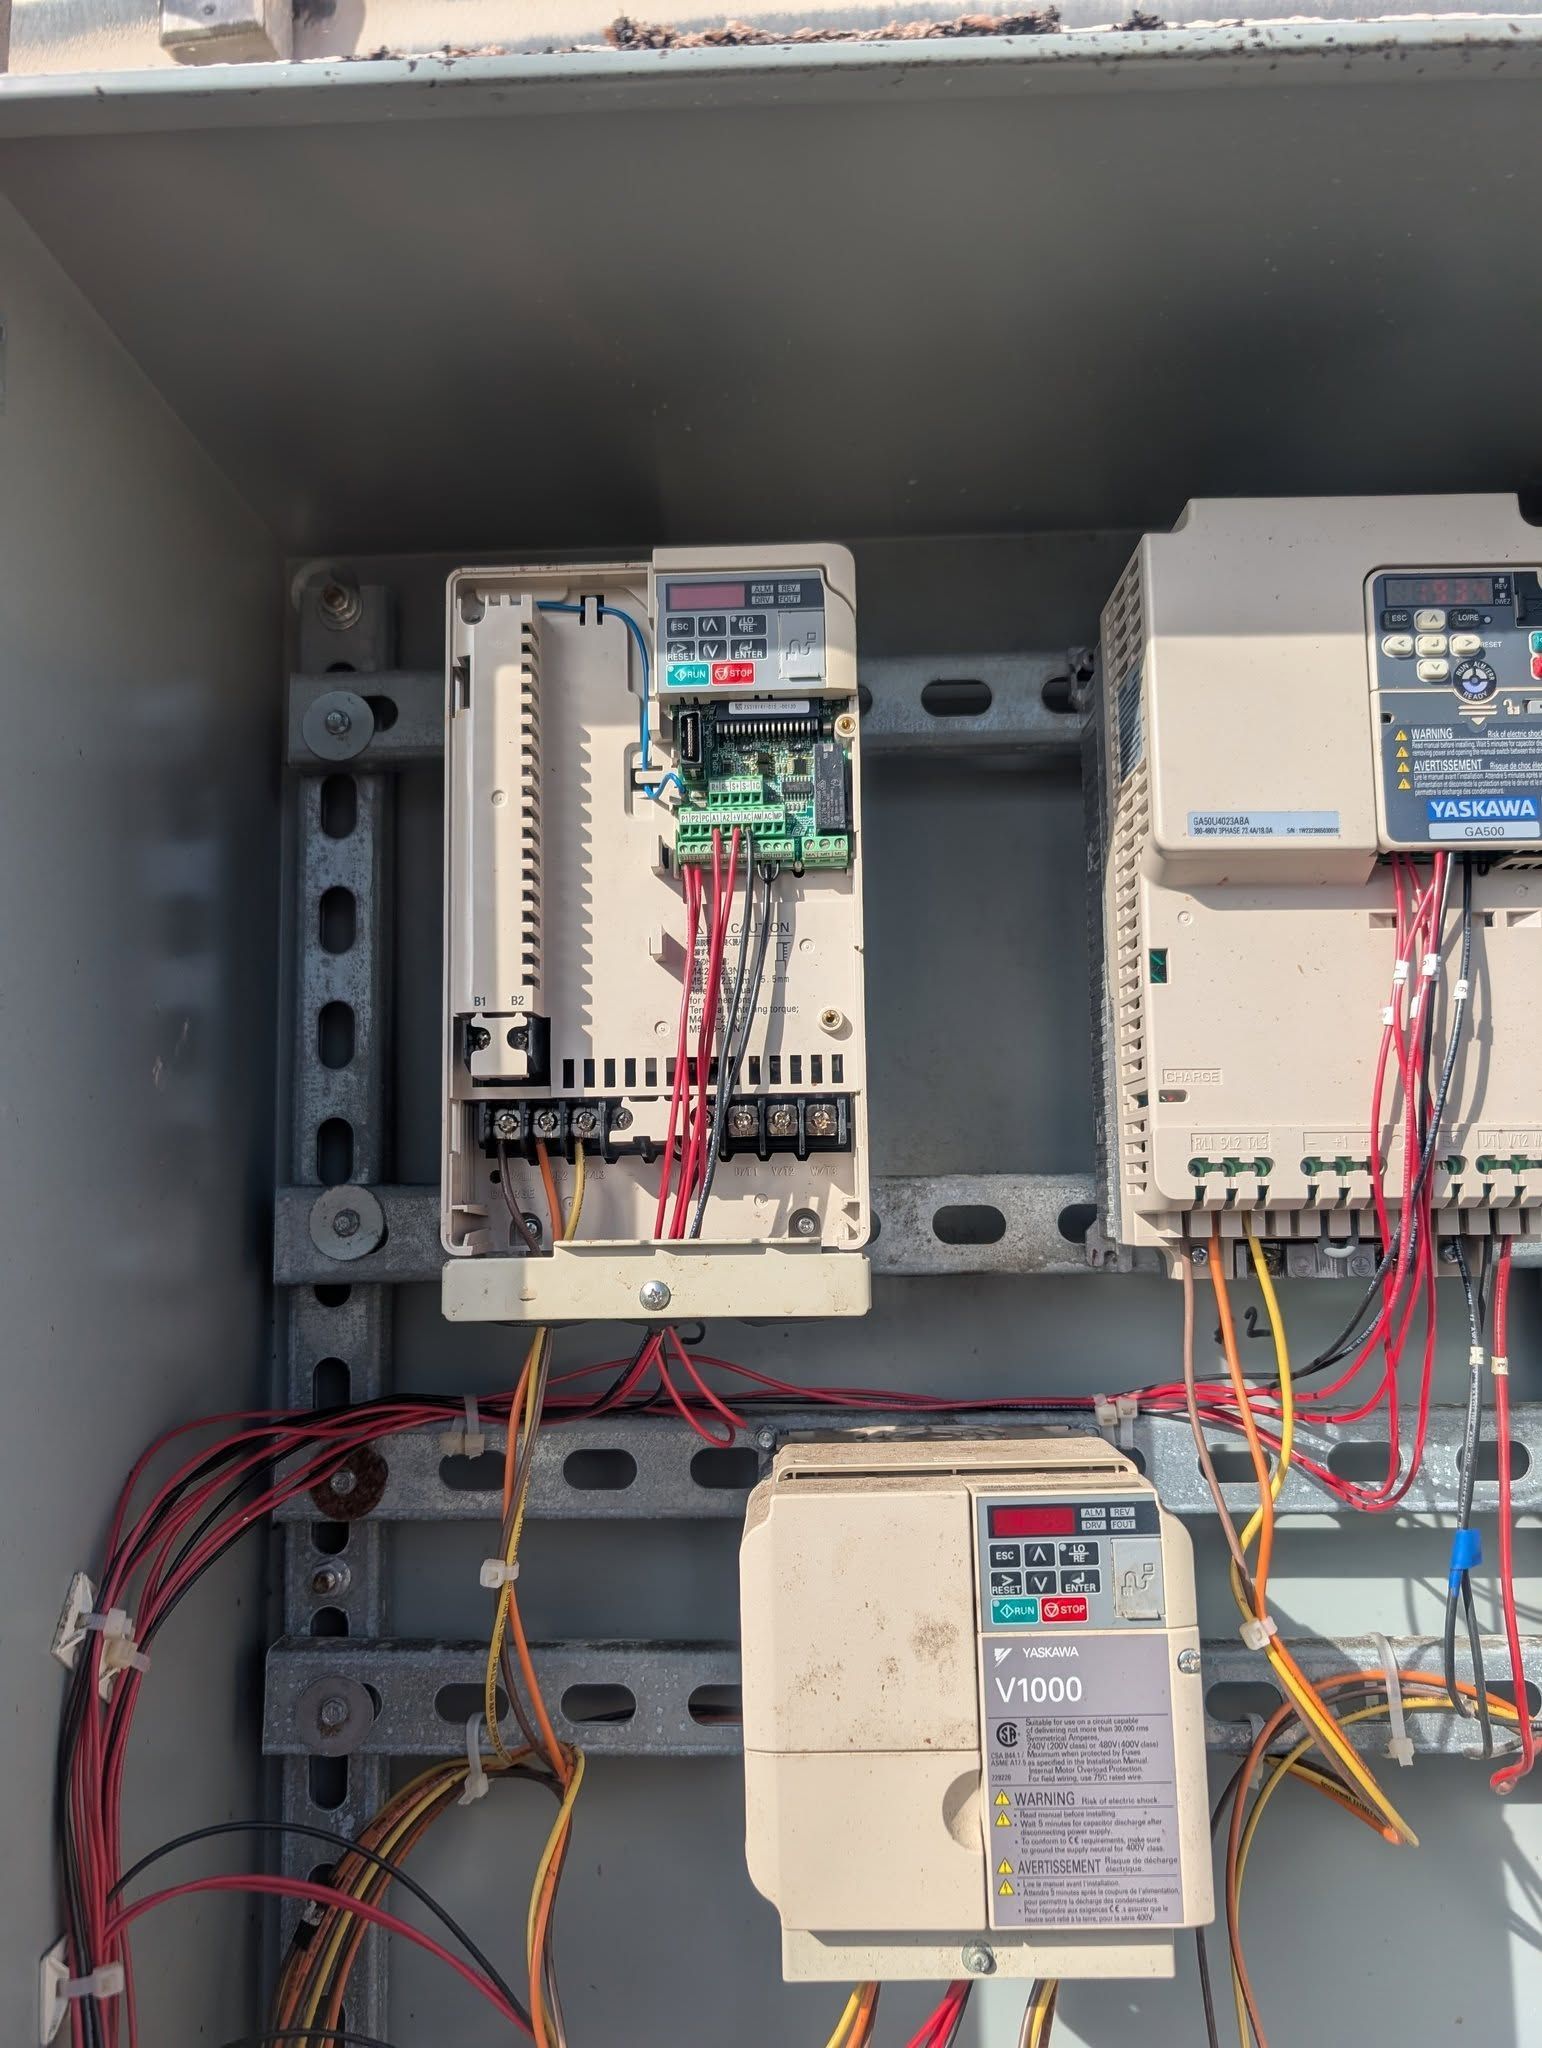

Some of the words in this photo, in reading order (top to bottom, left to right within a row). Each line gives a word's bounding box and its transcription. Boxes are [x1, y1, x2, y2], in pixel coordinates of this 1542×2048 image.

[753, 585, 771, 593] ALM
[781, 584, 797, 592] REV
[754, 596, 770, 604] DRV
[779, 595, 800, 603] FOUT
[742, 616, 754, 624] LO
[1391, 614, 1408, 622] ESC
[672, 623, 689, 631] ESC
[742, 625, 754, 633] RE
[667, 652, 695, 661] RESET
[734, 650, 763, 659] ENTER
[729, 669, 753, 678] STOP
[1455, 662, 1469, 676] RUN
[1473, 661, 1495, 681] ALM/ERR
[687, 670, 706, 679] RUN
[1462, 690, 1488, 700] READY
[1411, 728, 1453, 739] WARNING
[1487, 730, 1499, 738] Risk
[1507, 730, 1527, 738] electric
[1414, 759, 1483, 771] AVERTISSEMENT
[1490, 762, 1509, 770] Risque
[1518, 761, 1531, 769] choc
[742, 782, 750, 790] S-
[1430, 799, 1536, 818] YASKAWA
[681, 814, 689, 822] P1
[691, 814, 699, 822] P2
[701, 814, 710, 822] PC
[712, 814, 720, 822] A1
[722, 814, 730, 822] A2
[743, 813, 751, 821] AC
[753, 813, 762, 821] AM
[764, 813, 773, 821] AC
[774, 812, 783, 820] MP
[1464, 826, 1505, 837] GA500
[760, 976, 790, 984] 5.5mm
[474, 996, 486, 1007] B1
[511, 995, 524, 1006] B2
[771, 1005, 800, 1015] torque;
[1165, 1071, 1221, 1083] CHARGE
[1245, 1306, 1272, 1339] 2
[1084, 1508, 1103, 1517] ALM
[1113, 1507, 1131, 1516] REV
[1085, 1521, 1103, 1529] DRV
[1111, 1520, 1135, 1529] FOUT
[1072, 1544, 1086, 1553] LO
[995, 1551, 1014, 1560] ESC
[1073, 1554, 1085, 1563] RE
[991, 1585, 1022, 1595] RESET
[1065, 1583, 1096, 1593] ENTER
[1014, 1605, 1035, 1615] RUN
[1060, 1604, 1086, 1615] STOP
[1022, 1646, 1080, 1658] YASKAWA
[995, 1676, 1083, 1703] V1000
[1025, 1718, 1052, 1727] Suitable
[1093, 1717, 1112, 1725] circuit
[1113, 1717, 1139, 1726] capable
[1034, 1727, 1066, 1735] delivering
[1026, 1735, 1067, 1743] Symmetrical
[1027, 1742, 1046, 1751] 240V
[1046, 1742, 1068, 1751] (200V
[1069, 1742, 1088, 1750] class)
[1099, 1741, 1118, 1750] 480V
[1118, 1741, 1139, 1749] (400V
[1140, 1741, 1159, 1749] class)
[1027, 1750, 1060, 1759] Maximum
[1061, 1750, 1079, 1758] when
[1080, 1749, 1111, 1758] protected
[1112, 1749, 1121, 1758] by
[1036, 1759, 1065, 1768] specified
[1086, 1757, 1122, 1766] Installation
[1122, 1757, 1148, 1765] Manual
[1028, 1767, 1053, 1775] Internal
[1054, 1766, 1075, 1774] Motor
[1077, 1765, 1107, 1774] Overload
[1109, 1773, 1126, 1781] rated
[1014, 1791, 1076, 1806] WARNING
[1081, 1797, 1097, 1805] Risk
[1108, 1796, 1134, 1804] electric
[1020, 1811, 1037, 1819] Read
[1063, 1810, 1084, 1818] before
[1020, 1820, 1037, 1828] Wait
[1044, 1820, 1071, 1828] minutes
[1072, 1819, 1082, 1827] for
[1082, 1819, 1113, 1828] capacitor
[1114, 1818, 1146, 1827] discharge
[1147, 1818, 1162, 1826] after
[1018, 1859, 1101, 1874] AVERTISSEMENT
[1104, 1857, 1130, 1866] Risque
[1143, 1857, 1178, 1865] décharge
